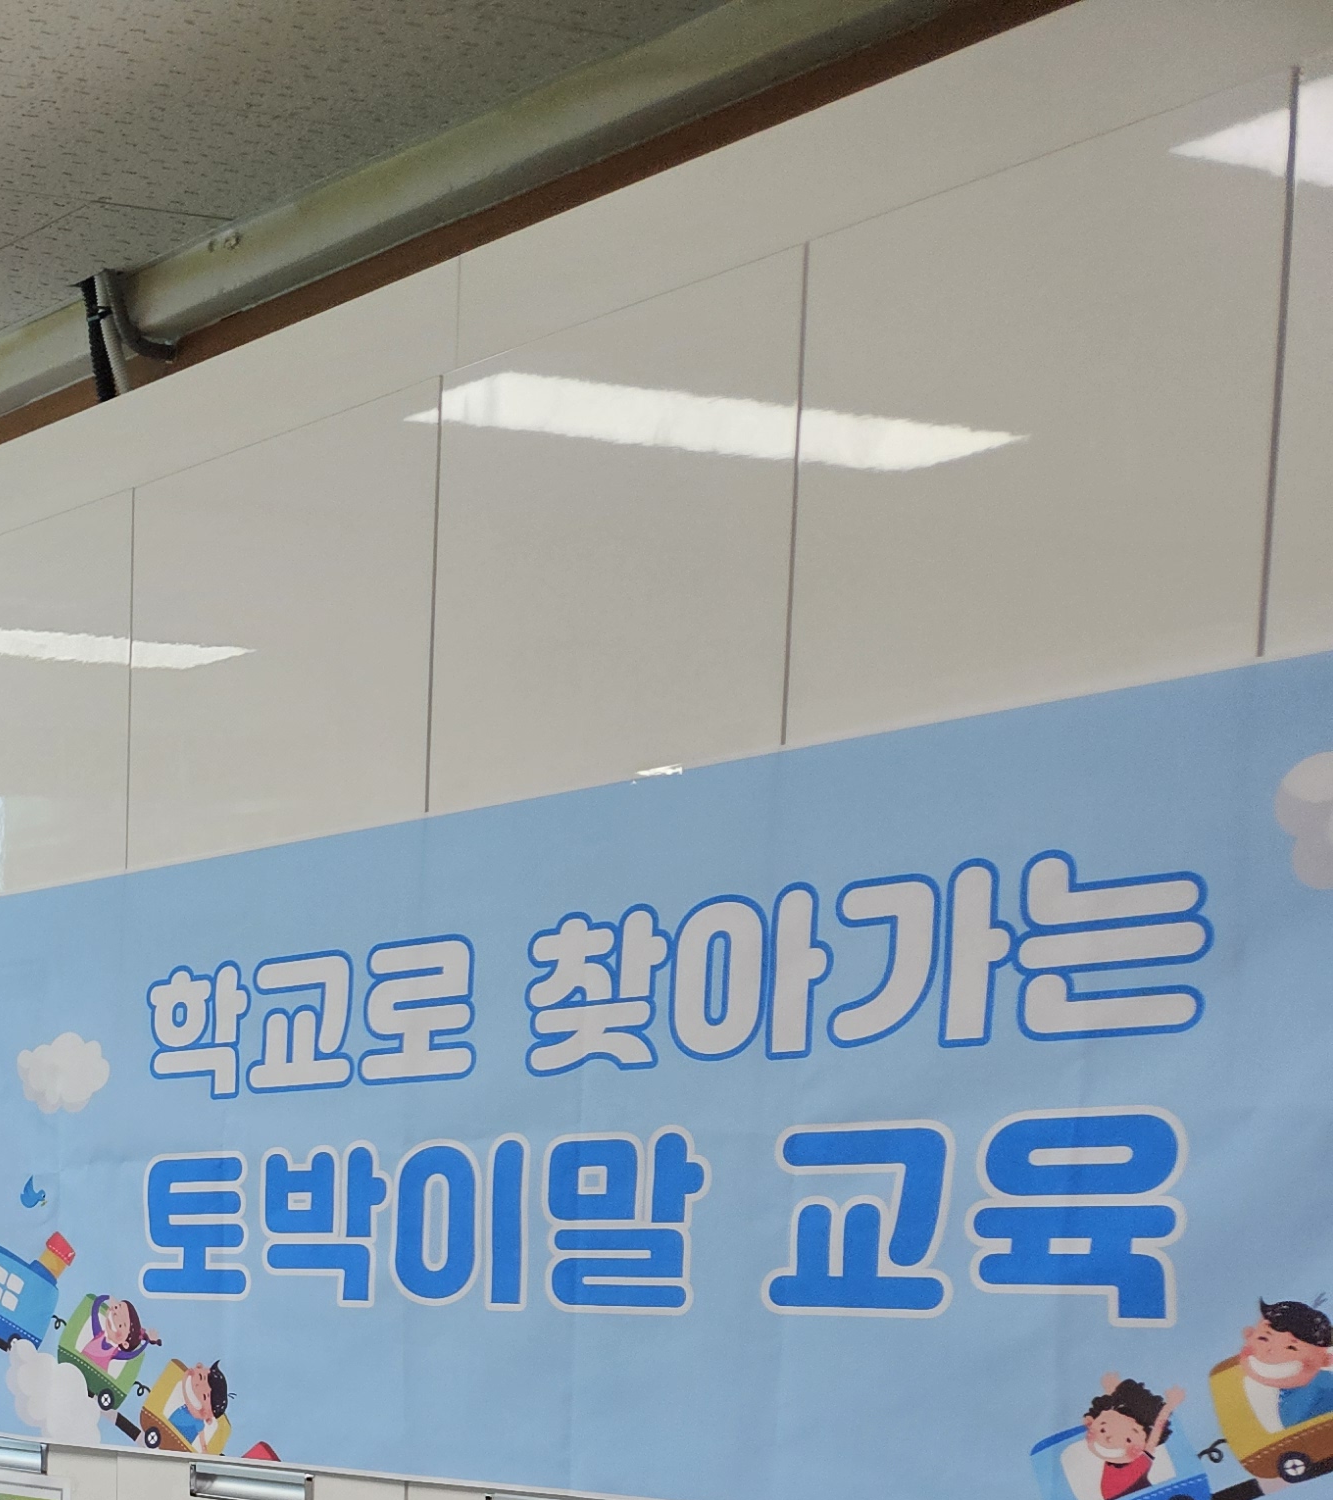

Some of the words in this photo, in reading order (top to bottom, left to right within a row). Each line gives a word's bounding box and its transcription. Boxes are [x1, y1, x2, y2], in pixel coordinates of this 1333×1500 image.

[146, 932, 477, 1097] 학교로
[529, 849, 1213, 1076] 찾아가는
[138, 1123, 712, 1311] 토박이말
[762, 1106, 1185, 1328] 교육
